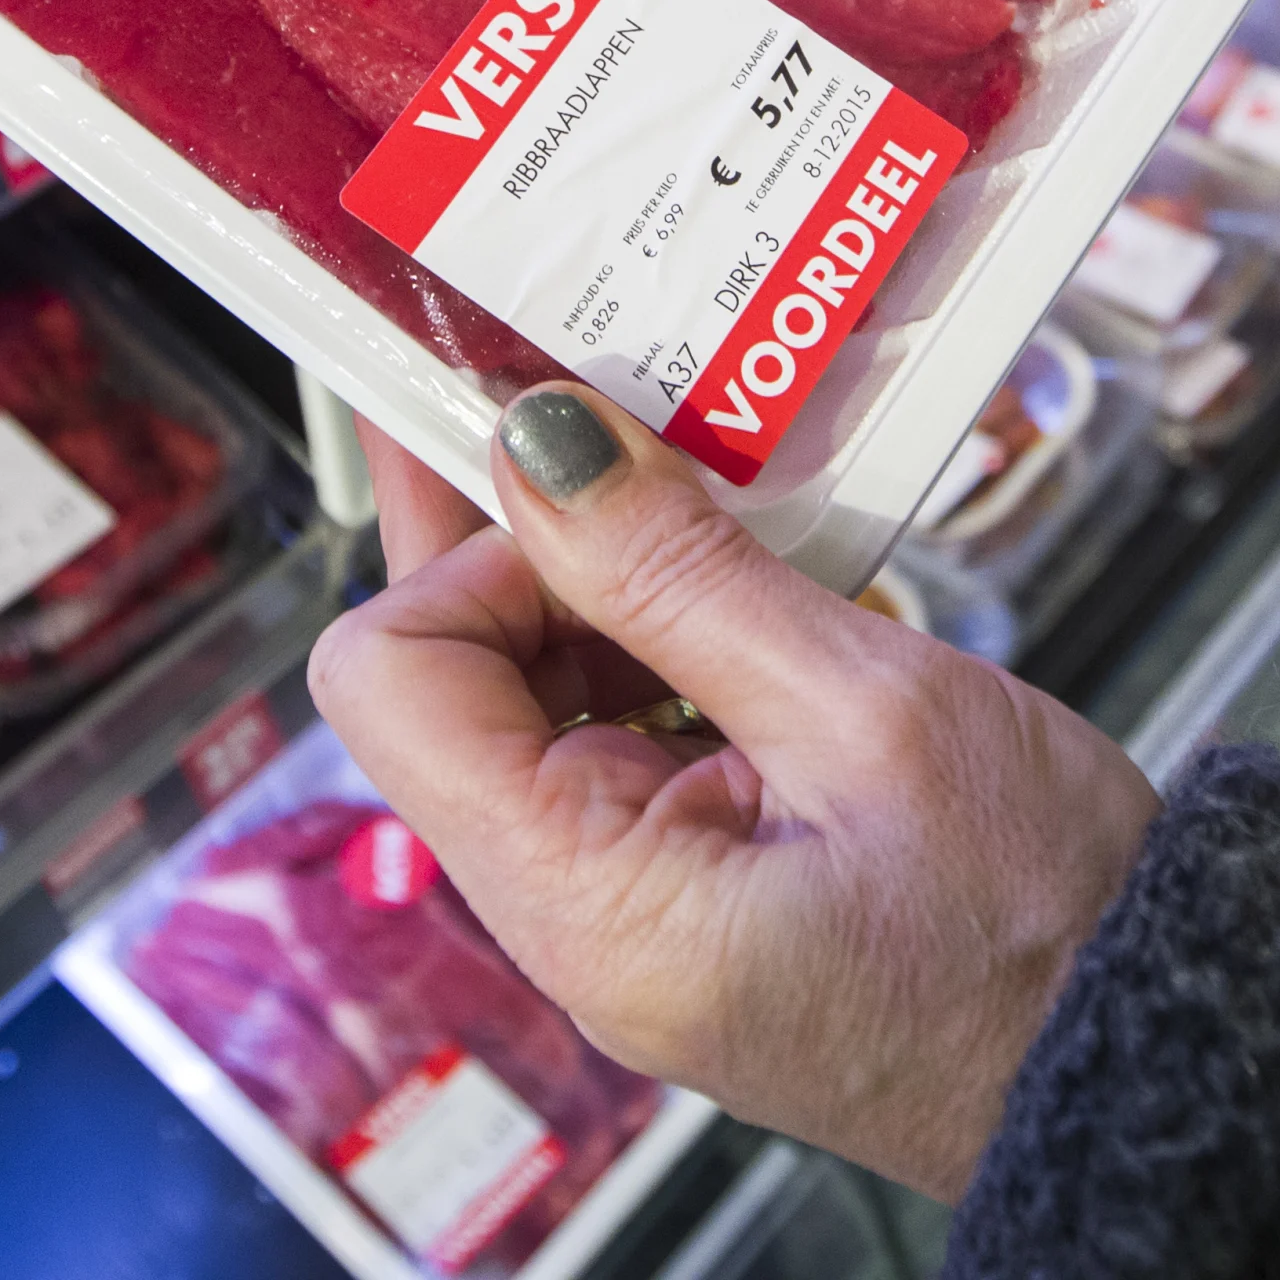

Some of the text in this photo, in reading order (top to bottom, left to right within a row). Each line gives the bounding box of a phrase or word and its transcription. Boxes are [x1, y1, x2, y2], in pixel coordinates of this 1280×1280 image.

[730, 27, 779, 91] TOTAALPRIJS
[502, 17, 645, 200] RIBBRAADLAPPEN
[710, 39, 813, 187] € 5,77
[802, 84, 871, 178] 8-12-2015
[744, 199, 760, 214] TE
[755, 138, 802, 202] GEBRUIKEN
[793, 116, 815, 142] TOT
[809, 99, 828, 119] EN
[622, 172, 678, 246] PRIJS PER KILO
[642, 203, 684, 259] € 6,99
[562, 263, 614, 332] INHOUD KG
[703, 139, 938, 435] VOORDEEL
[713, 231, 780, 314] DIRK 3
[581, 299, 620, 346] 0,826
[657, 341, 699, 405] A37
